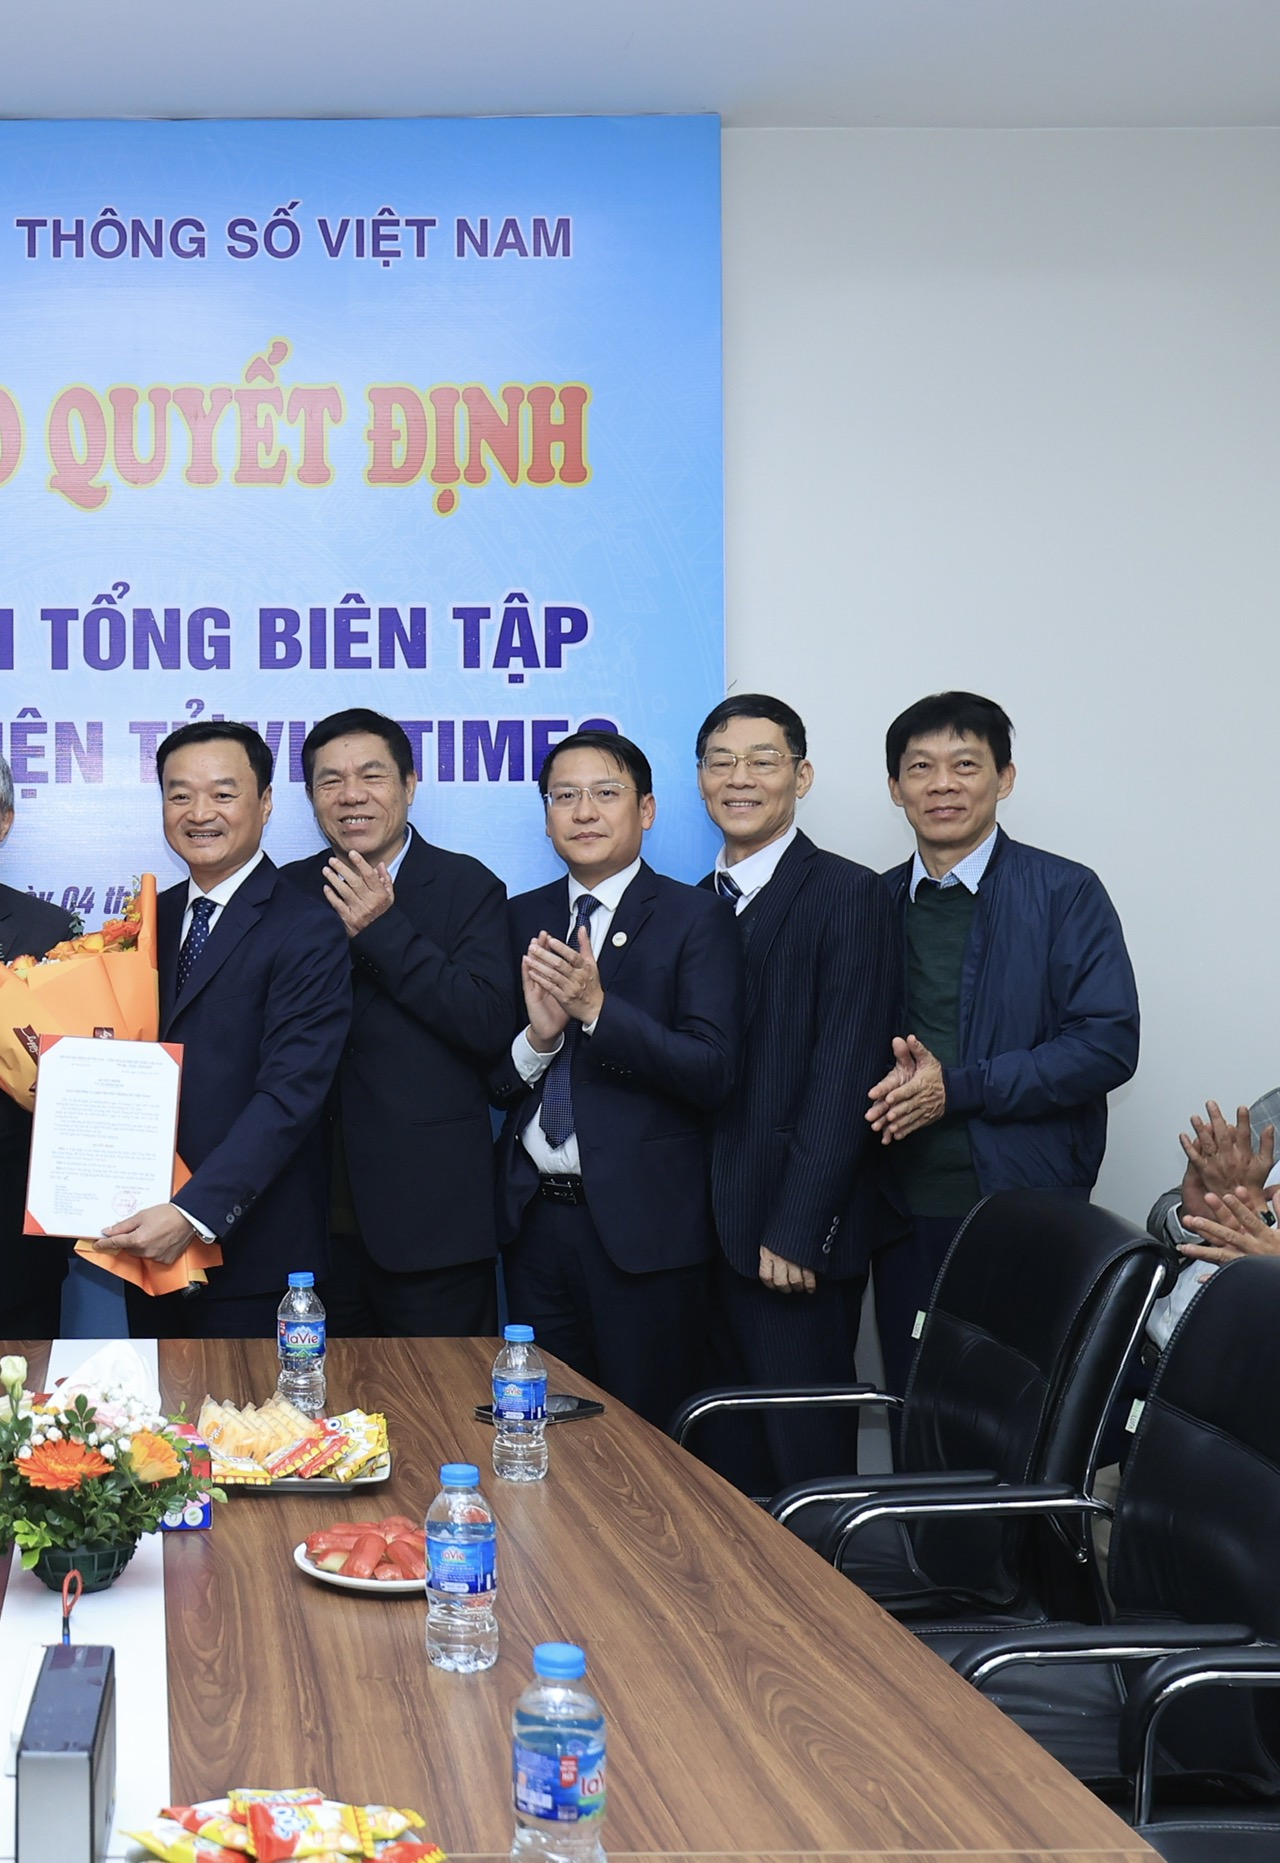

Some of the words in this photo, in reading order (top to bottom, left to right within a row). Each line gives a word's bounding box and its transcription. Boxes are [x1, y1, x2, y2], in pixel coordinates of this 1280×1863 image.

[16, 207, 206, 259] THÔNG
[227, 201, 300, 259] SỐ
[318, 207, 436, 267] VIỆT
[456, 218, 571, 258] NAM
[48, 339, 343, 510] QUYẾT
[366, 385, 589, 514] ĐỊNH
[40, 581, 230, 671] TỔNG
[259, 593, 426, 669] BIÊN
[453, 592, 588, 684] TẬP
[61, 886, 95, 914] 04
[287, 1332, 319, 1343] laVie
